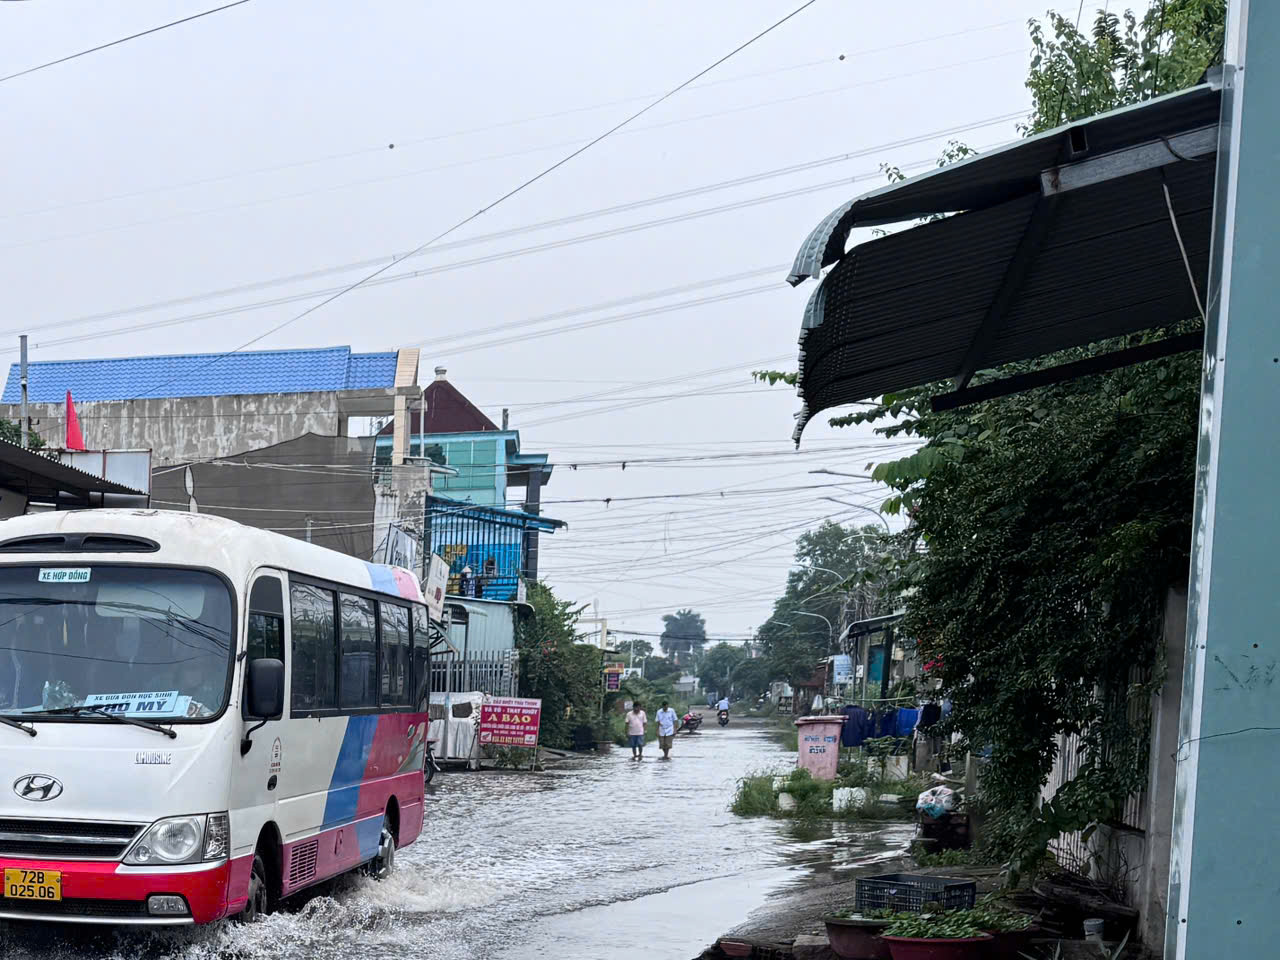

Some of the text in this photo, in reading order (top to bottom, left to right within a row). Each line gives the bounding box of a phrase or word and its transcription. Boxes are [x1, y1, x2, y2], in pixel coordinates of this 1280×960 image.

[42, 571, 51, 580] XE
[136, 698, 167, 711] MỸ
[488, 713, 498, 721] A
[20, 870, 45, 884] 72B
[10, 884, 55, 898] 025.06
